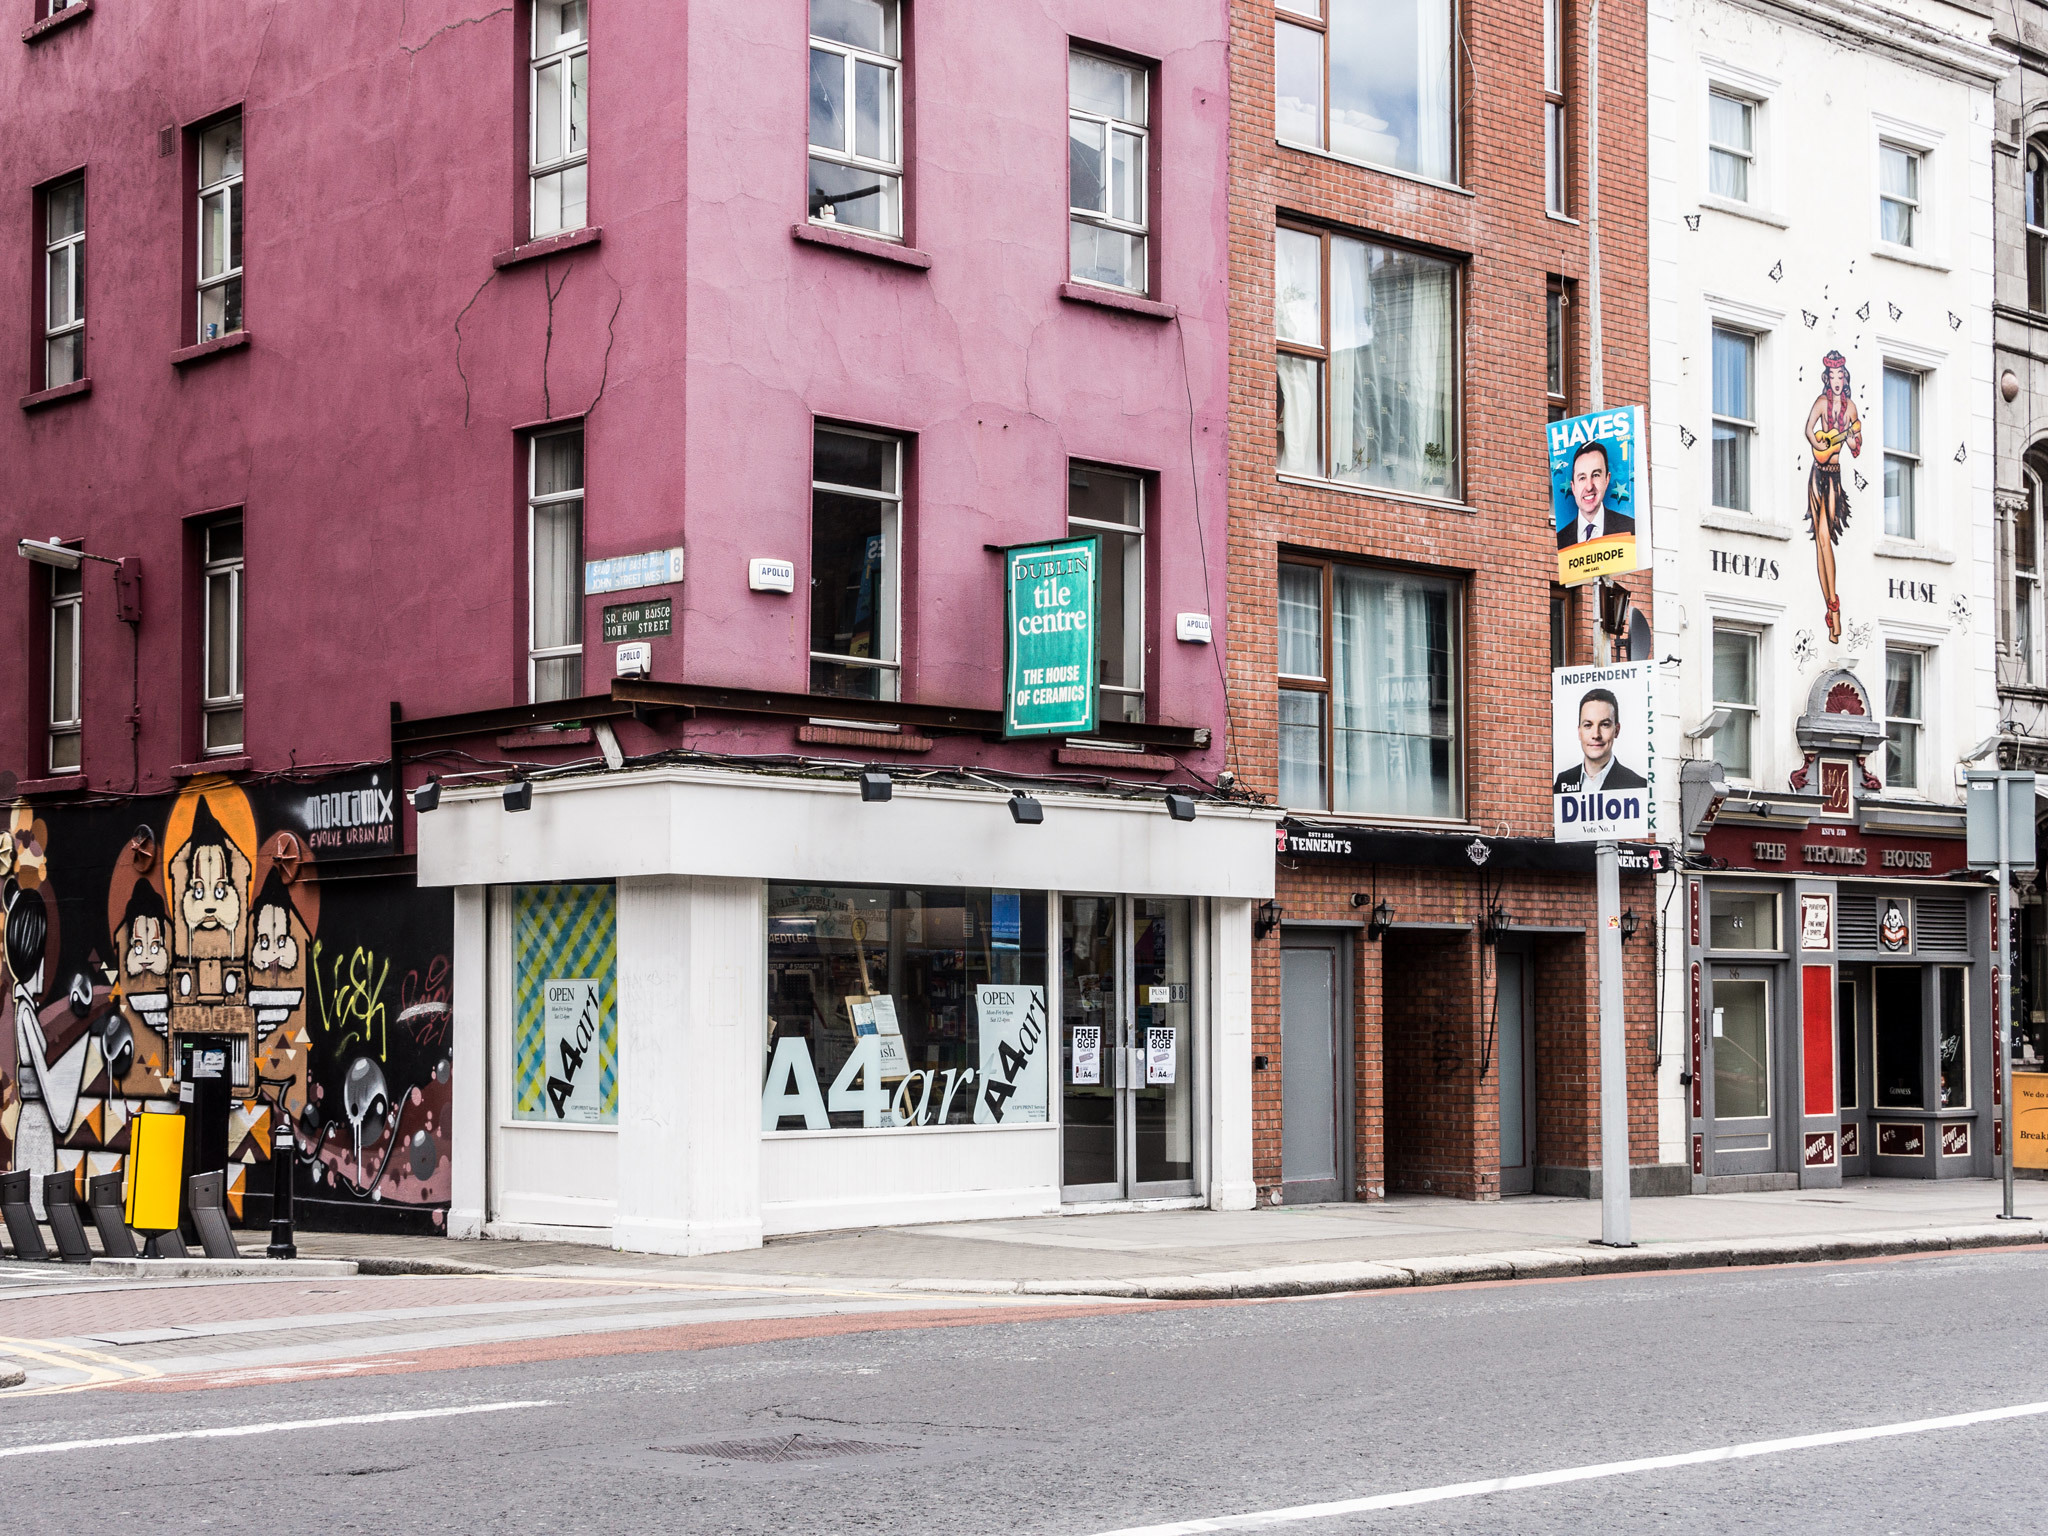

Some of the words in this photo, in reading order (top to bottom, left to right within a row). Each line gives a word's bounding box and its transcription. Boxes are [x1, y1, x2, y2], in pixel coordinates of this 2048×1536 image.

[1551, 412, 1630, 451] HAYES
[1616, 434, 1631, 442] VOTE
[1619, 440, 1628, 461] 1
[673, 556, 681, 573] 8
[1015, 555, 1089, 581] DUBLIN
[1568, 554, 1585, 569] FOR
[1586, 548, 1624, 565] EUROPE
[1710, 549, 1780, 581] THOMAS
[592, 577, 612, 590] JOHN
[615, 573, 642, 587] STREET
[645, 569, 665, 582] WEST
[761, 566, 790, 578] APOLLO
[1033, 577, 1070, 608] tile
[1888, 578, 1938, 604] HOUSE
[606, 624, 627, 637] JOHN
[638, 619, 669, 634] STREET
[1018, 608, 1086, 635] centre
[1186, 619, 1209, 630] APOLLO
[620, 650, 641, 661] APOLLO
[1023, 669, 1044, 686] THE
[1046, 665, 1080, 683] HOUSE
[1561, 668, 1638, 686] INDEPENDENT
[1017, 690, 1031, 706] OF
[1032, 685, 1085, 704] CERAMICS
[1561, 782, 1580, 793] Paul
[1561, 793, 1640, 823] Dillon
[309, 830, 343, 848] EVOLVE
[346, 826, 375, 844] URBAN
[377, 824, 393, 844] ART
[1582, 825, 1597, 834] Vote
[1599, 824, 1611, 833] No.
[1612, 824, 1616, 832] 1
[1289, 836, 1352, 854] TENNENT'S
[1754, 842, 1787, 861] THE
[1803, 845, 1867, 866] THOMAS
[1882, 850, 1932, 869] HOUSE
[549, 987, 575, 1001] OPEN
[982, 991, 1015, 1005] OPEN
[1151, 988, 1167, 996] PUSH
[1075, 1029, 1098, 1039] FREE
[1077, 1038, 1096, 1048] 8GB
[1149, 1030, 1174, 1040] FREE
[547, 984, 599, 1119] A4art
[1151, 1039, 1171, 1049] 8GB
[761, 1034, 997, 1131] A4art
[1889, 1086, 1912, 1095] GUINNESS
[1942, 1126, 1957, 1147] STOUT
[1951, 1132, 1967, 1153] LAGER
[1805, 1136, 1827, 1160] PORTER
[1823, 1145, 1833, 1162] ALE
